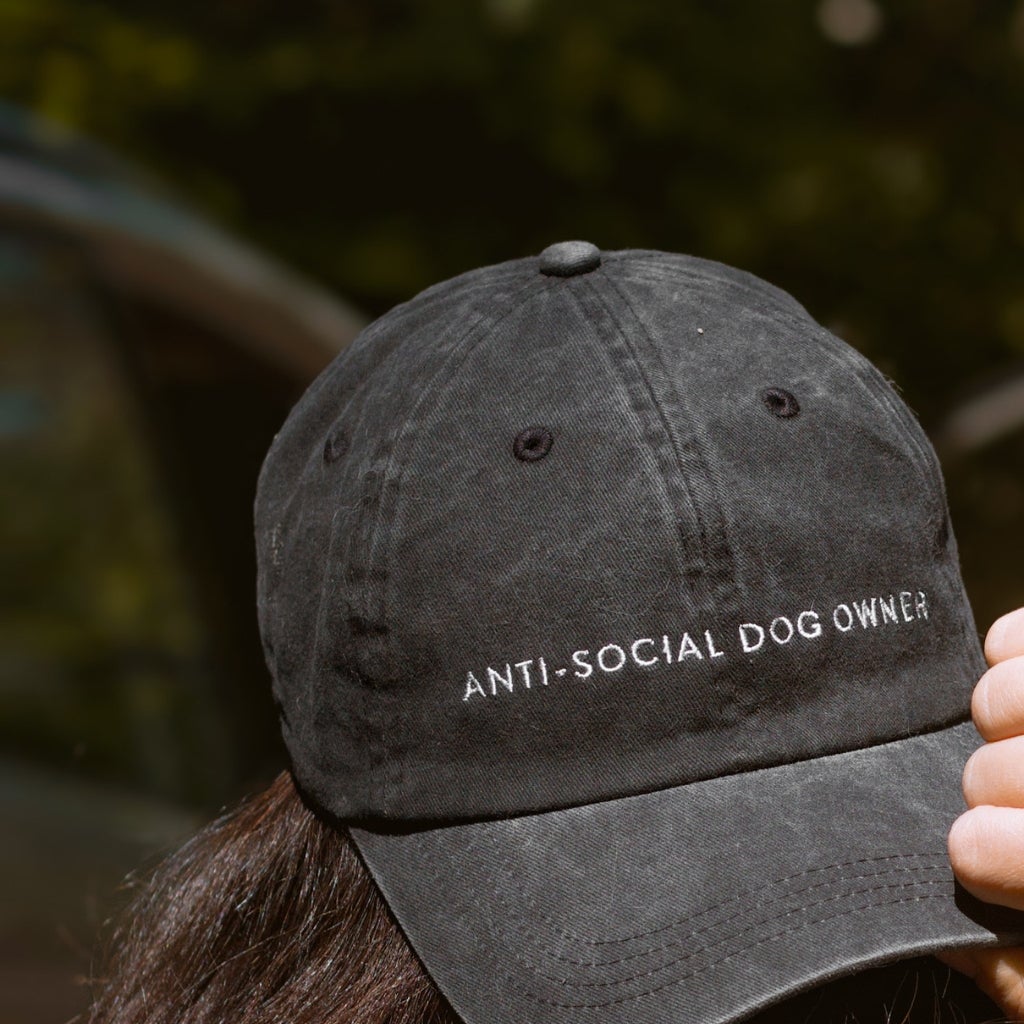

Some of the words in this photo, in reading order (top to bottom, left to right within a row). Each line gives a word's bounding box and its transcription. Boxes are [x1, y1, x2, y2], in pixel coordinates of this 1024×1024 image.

[463, 629, 725, 702] ANTI-SOCIAL
[738, 609, 823, 653] DOG
[832, 591, 929, 633] OWNER
